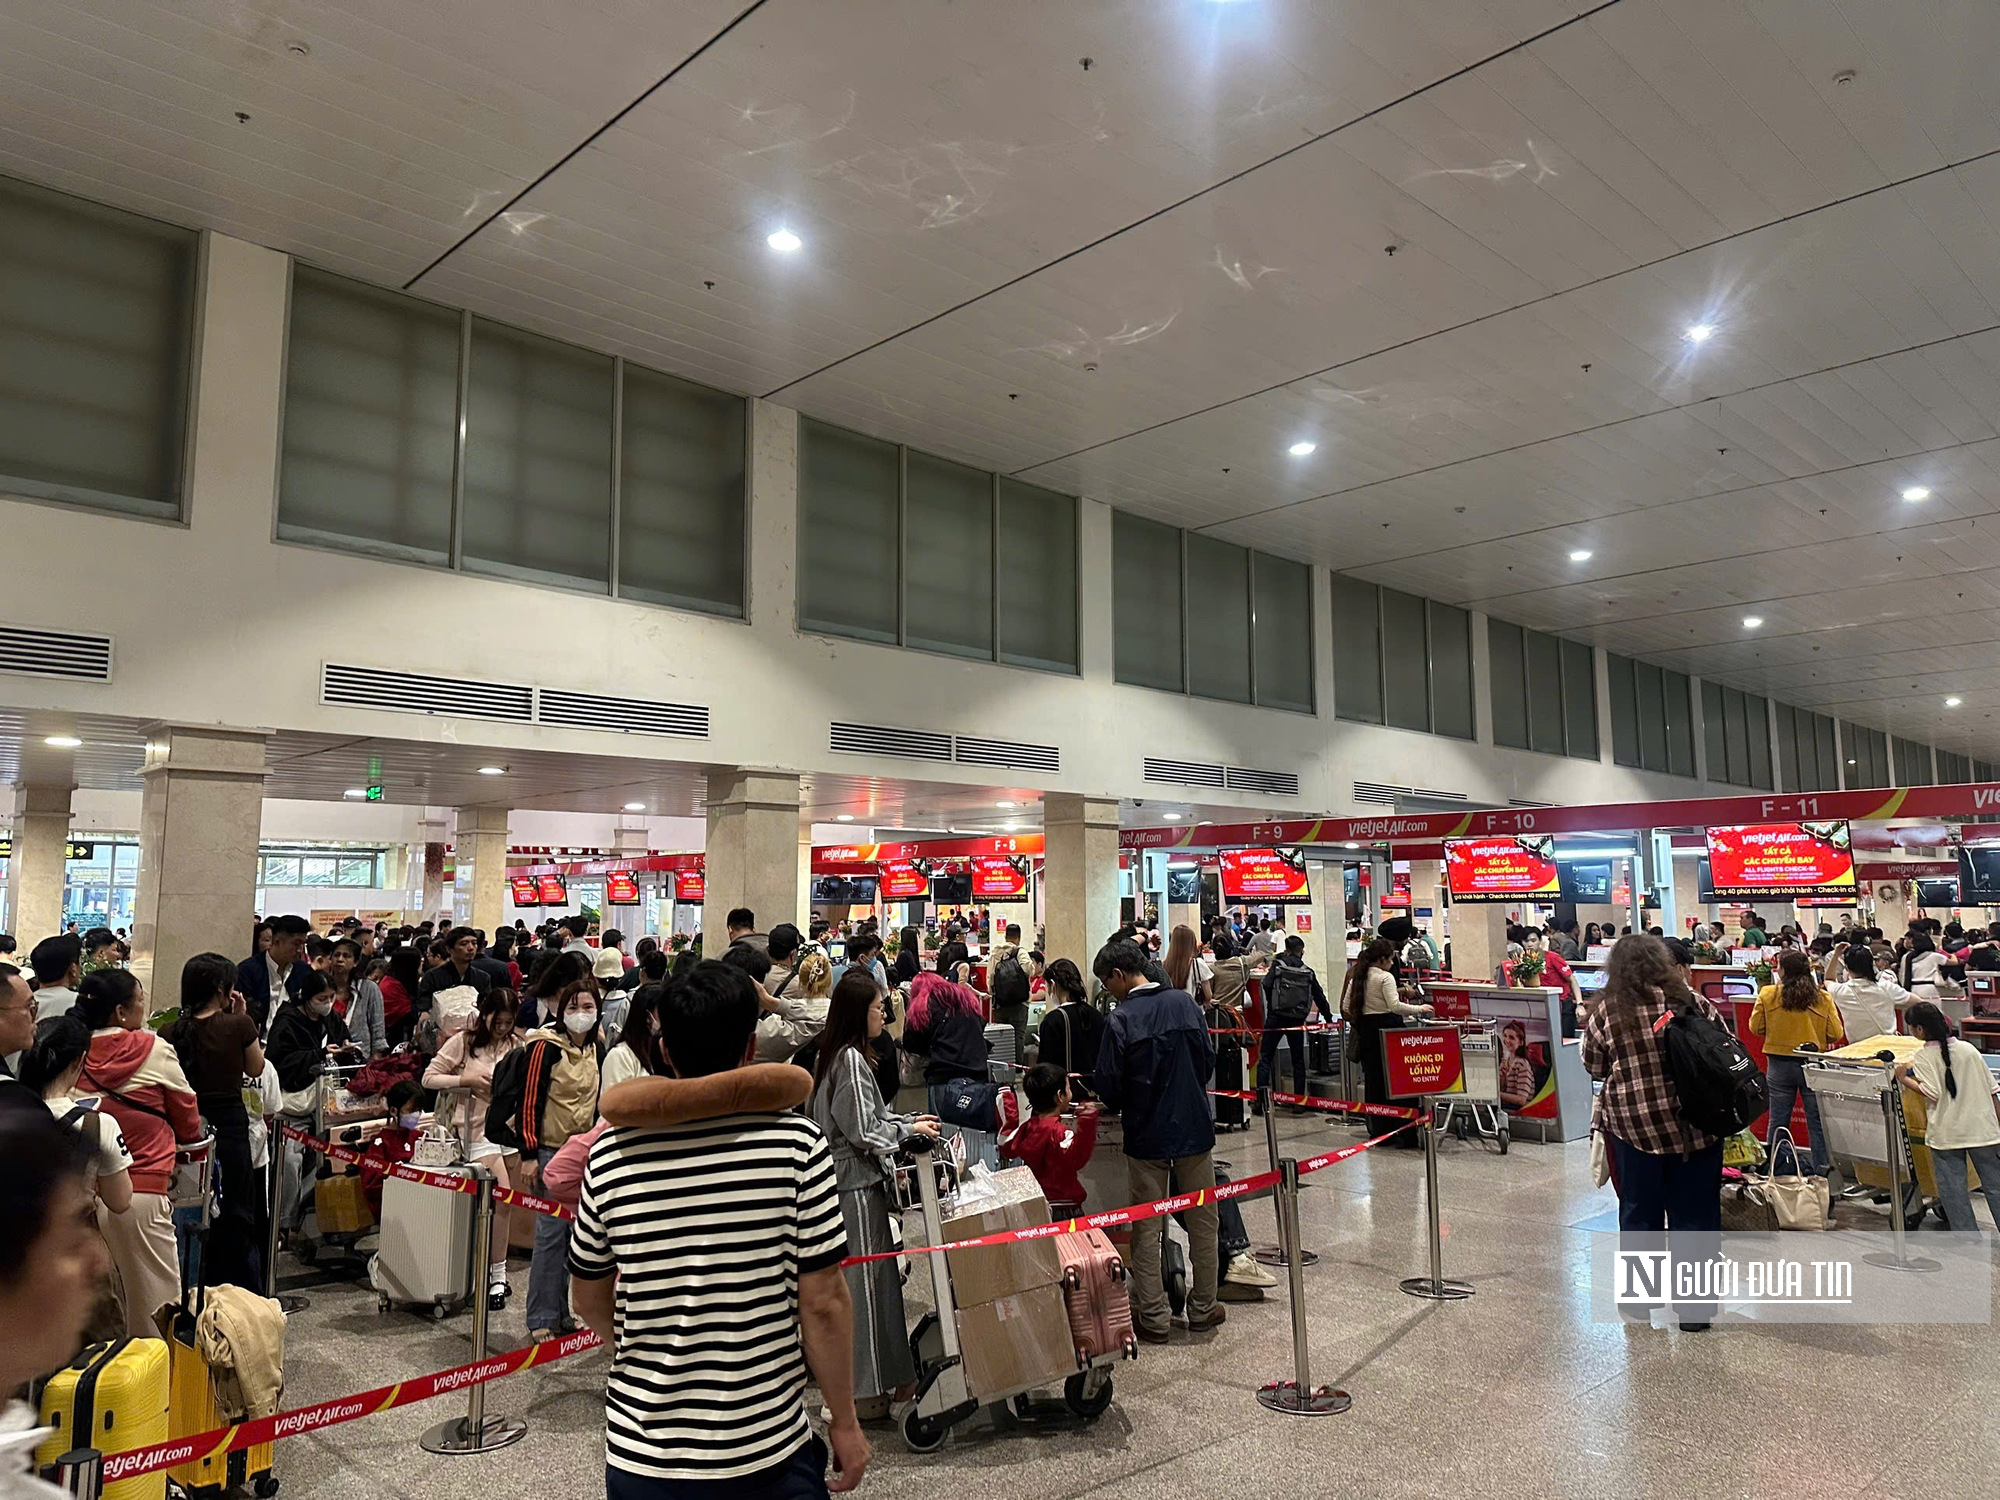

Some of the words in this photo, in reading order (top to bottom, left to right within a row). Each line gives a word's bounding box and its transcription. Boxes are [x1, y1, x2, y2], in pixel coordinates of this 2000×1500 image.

[1763, 846, 1778, 855] TẤT
[1779, 845, 1792, 855] CẢ
[1744, 856, 1760, 865] CÁC
[1762, 854, 1796, 864] CHUYẾN
[1797, 856, 1815, 864] BAY
[1404, 1053, 1433, 1064] KHÔNG
[1434, 1053, 1444, 1062] ĐI
[1409, 1063, 1423, 1076] LỐI
[1424, 1065, 1441, 1075] NÀY
